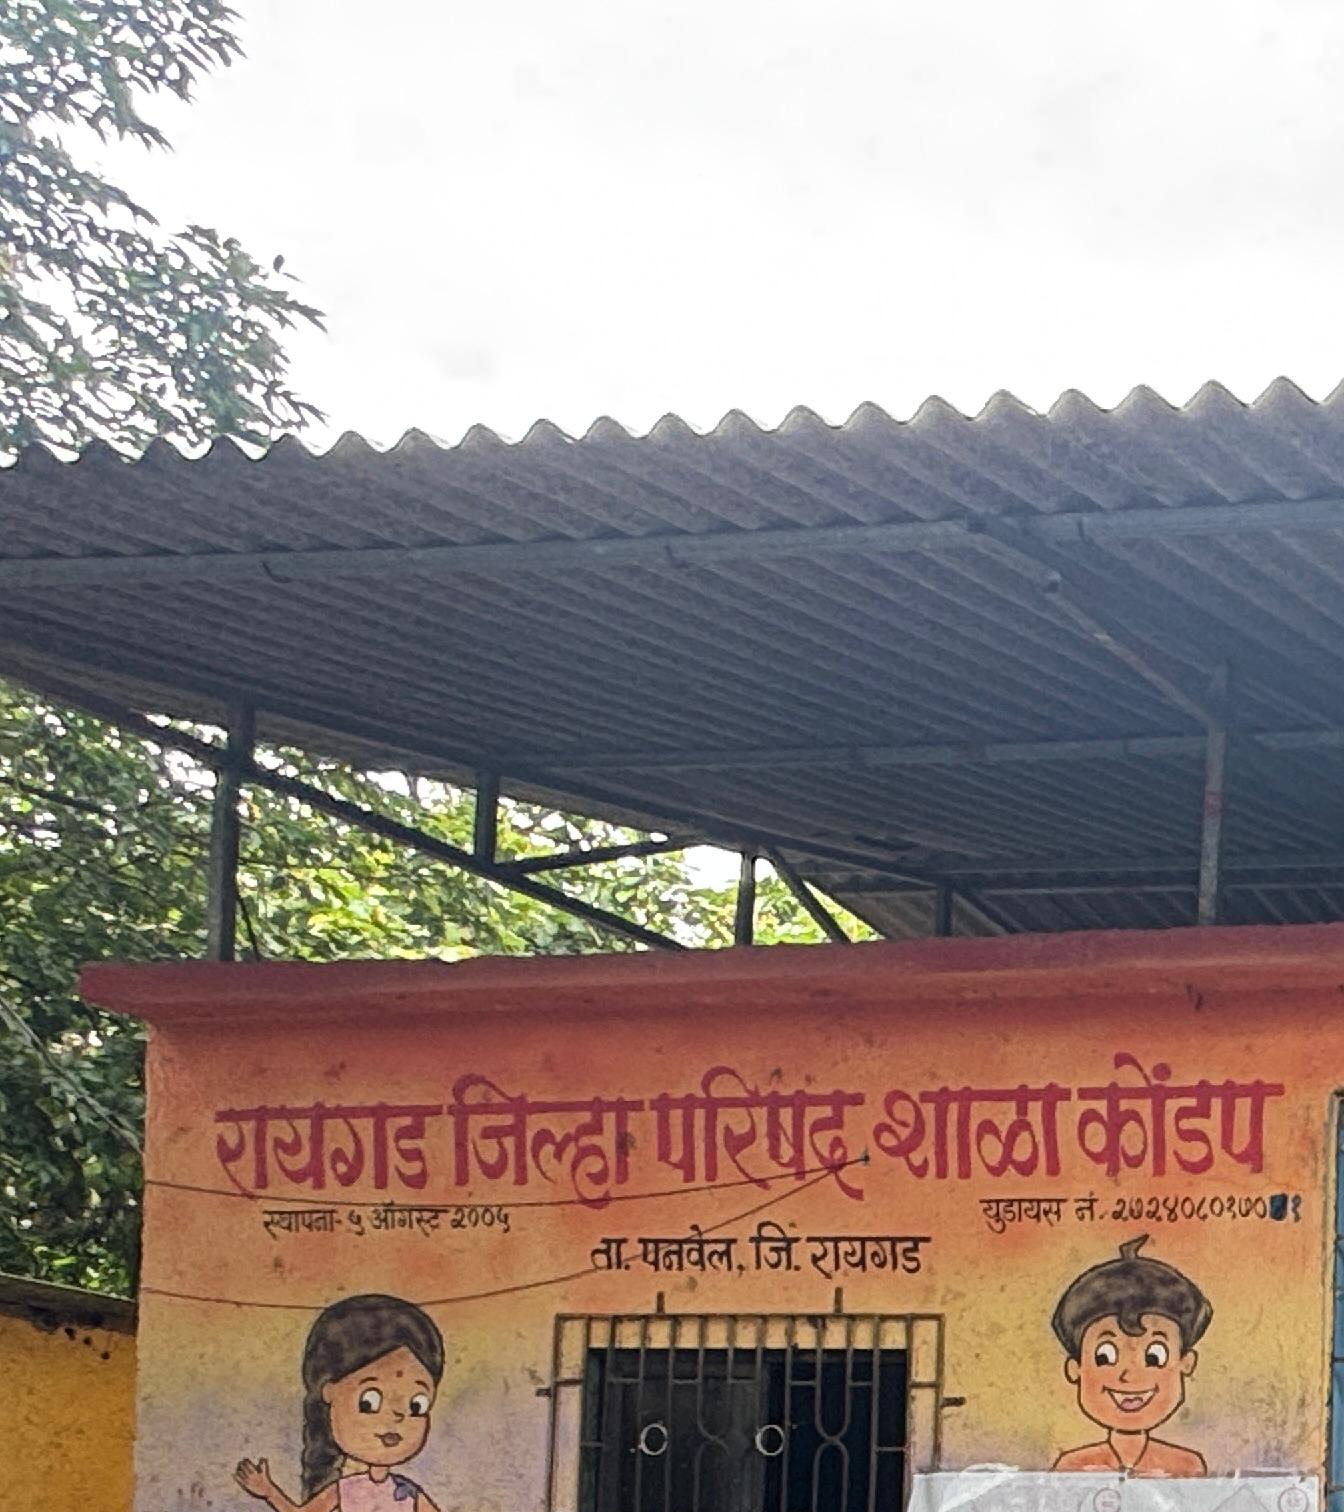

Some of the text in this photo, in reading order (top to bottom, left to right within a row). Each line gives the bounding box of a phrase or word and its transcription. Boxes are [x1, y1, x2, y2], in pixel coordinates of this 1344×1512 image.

[215, 1102, 443, 1200] रायगड
[447, 1072, 644, 1211] जिल्हा
[873, 1082, 1071, 1180] शाळा
[1077, 1052, 1286, 1177] कोंडप
[450, 1205, 511, 1233] २००५
[979, 1197, 1067, 1234] युडायस
[590, 1236, 631, 1272] ता.
[749, 1219, 800, 1272] जि.
[807, 1234, 932, 1279] रायगड
